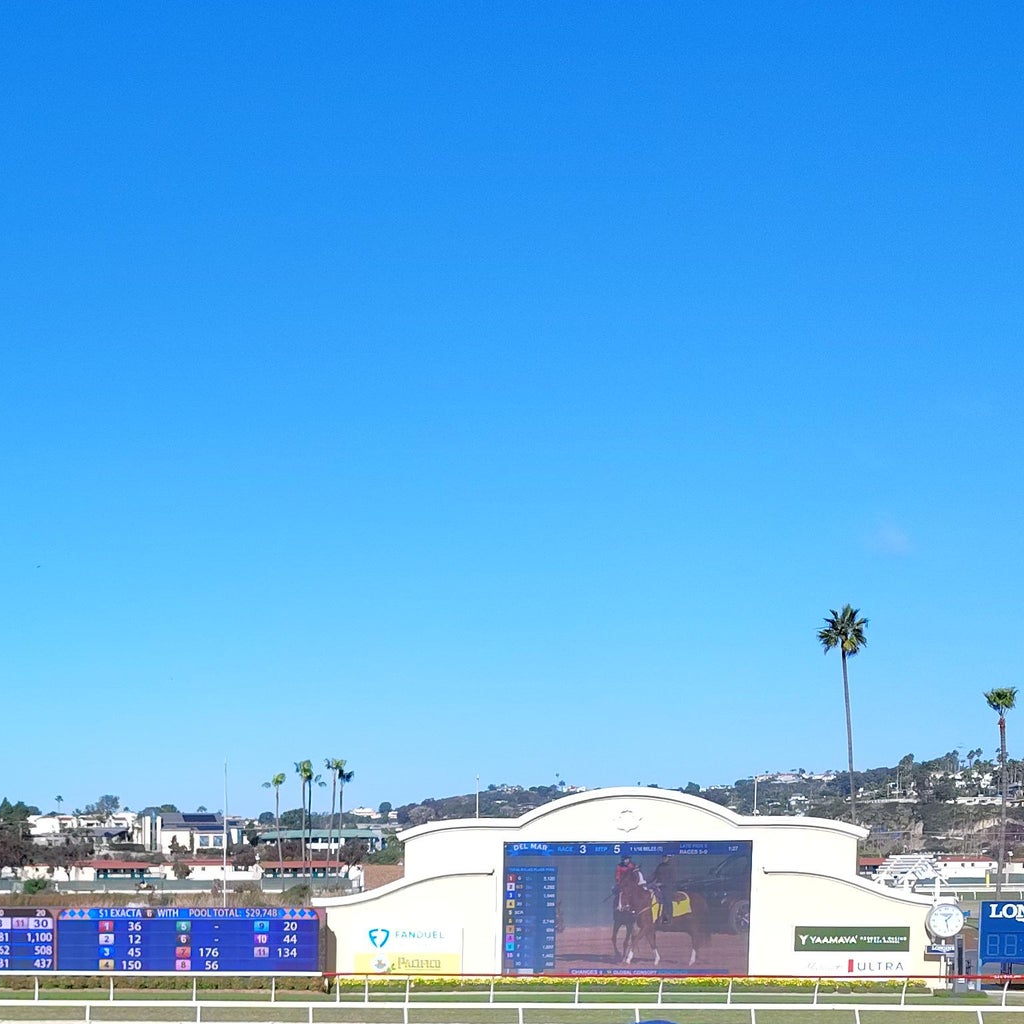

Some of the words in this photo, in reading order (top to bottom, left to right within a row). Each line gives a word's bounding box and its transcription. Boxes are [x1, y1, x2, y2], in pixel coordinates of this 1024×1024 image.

[513, 843, 528, 851] DEL
[531, 843, 548, 851] MAR
[579, 845, 586, 854] 3
[613, 845, 621, 854] 5
[110, 909, 142, 918] EXACTA
[157, 909, 179, 918] WITH
[189, 909, 211, 918] POOL
[214, 909, 242, 918] TOTAL:
[16, 918, 24, 928] 11
[34, 918, 48, 928] 30
[104, 922, 109, 930] 1
[128, 922, 142, 930] 36
[181, 922, 187, 930] 5
[259, 922, 264, 930] 9
[283, 922, 298, 930] 20
[26, 931, 52, 942] 1,100
[104, 934, 110, 944] 2
[128, 934, 142, 944] 12
[180, 934, 187, 944] 6
[257, 934, 266, 944] 10
[283, 934, 298, 944] 44
[395, 931, 445, 939] FANDUEL
[34, 944, 52, 954] 508
[104, 948, 110, 957] 3
[128, 948, 142, 957] 45
[181, 948, 186, 957] 7
[199, 948, 219, 957] 176
[258, 948, 266, 957] 11
[277, 948, 298, 957] 134
[34, 956, 52, 968] 437
[104, 960, 110, 970] 4
[122, 960, 142, 970] 150
[180, 960, 186, 970] 8
[205, 960, 219, 970] 56
[858, 962, 904, 971] ULTRA
